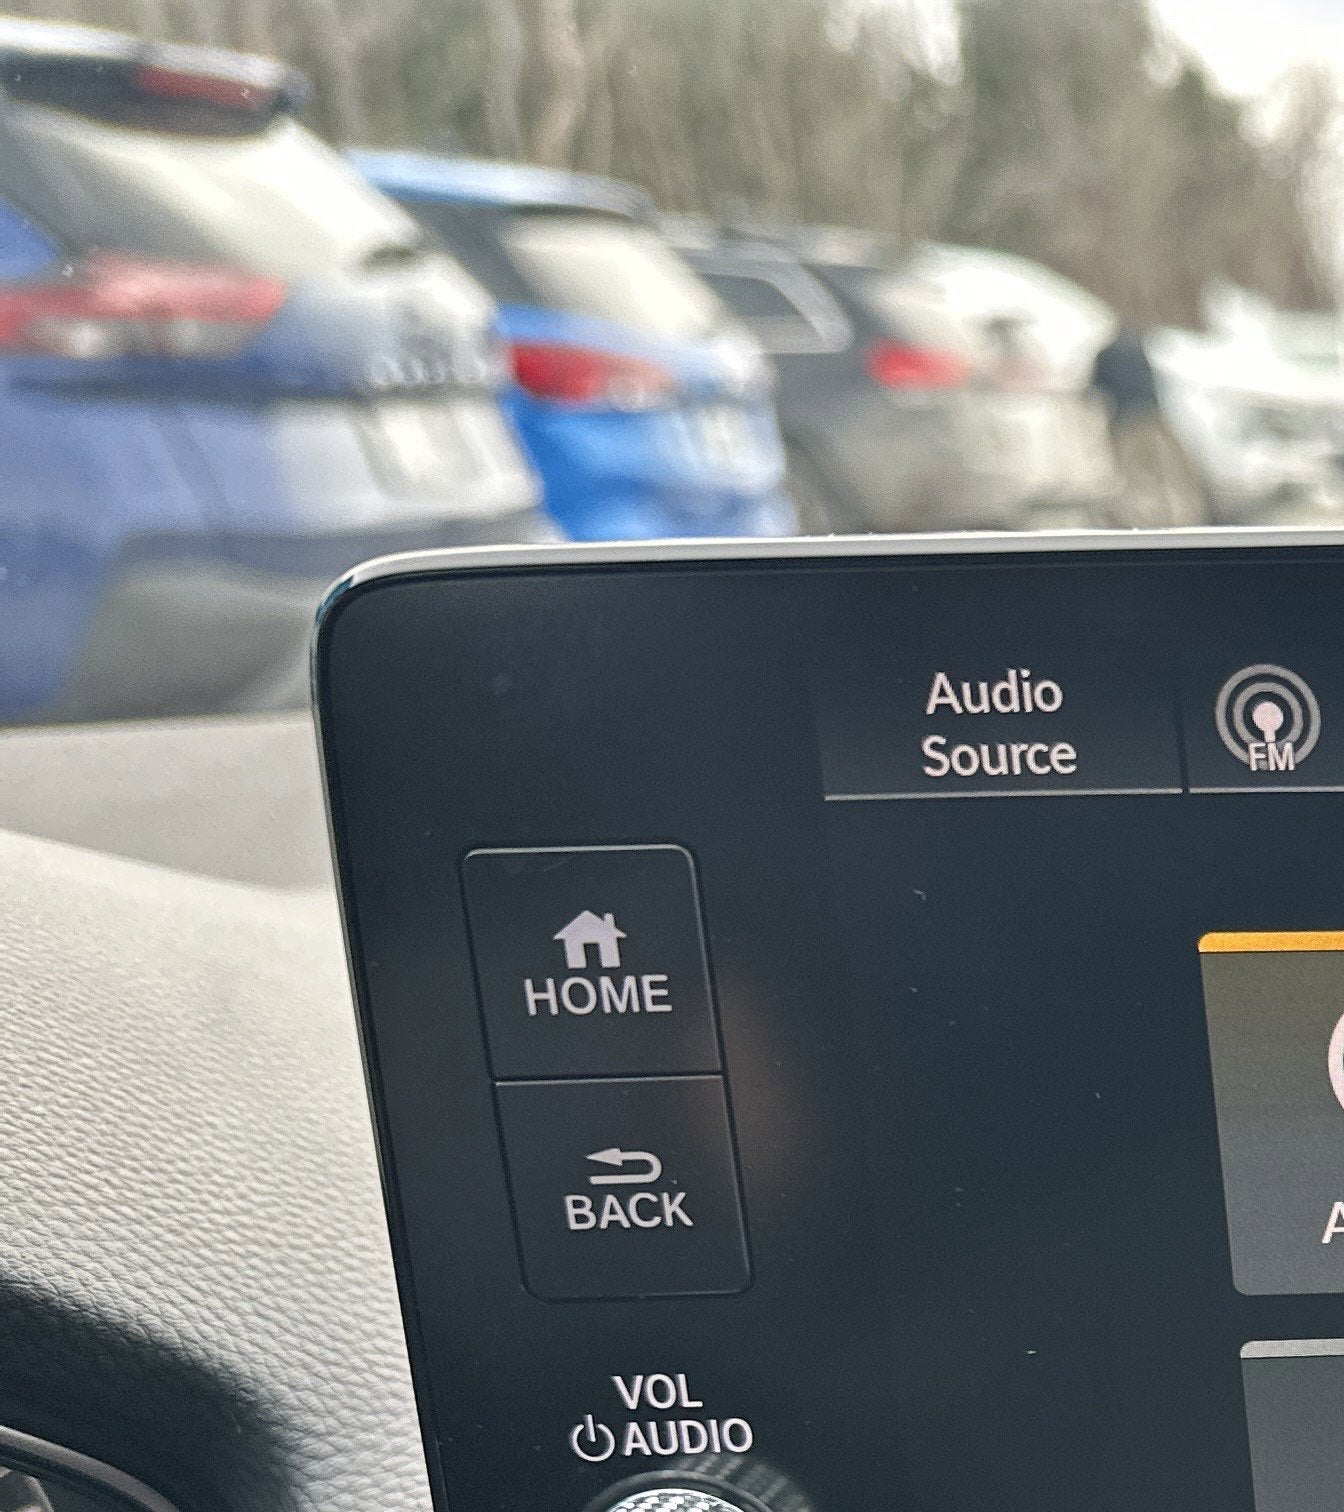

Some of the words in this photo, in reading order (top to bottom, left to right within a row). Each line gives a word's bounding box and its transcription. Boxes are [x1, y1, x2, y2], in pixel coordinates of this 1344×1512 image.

[926, 668, 1063, 715] Audio
[922, 734, 1077, 777] Source
[1247, 742, 1296, 772] FM
[524, 974, 673, 1016] HOME
[565, 1191, 694, 1230] BACK
[611, 1373, 704, 1410] VOL
[623, 1417, 753, 1456] AUDIO
